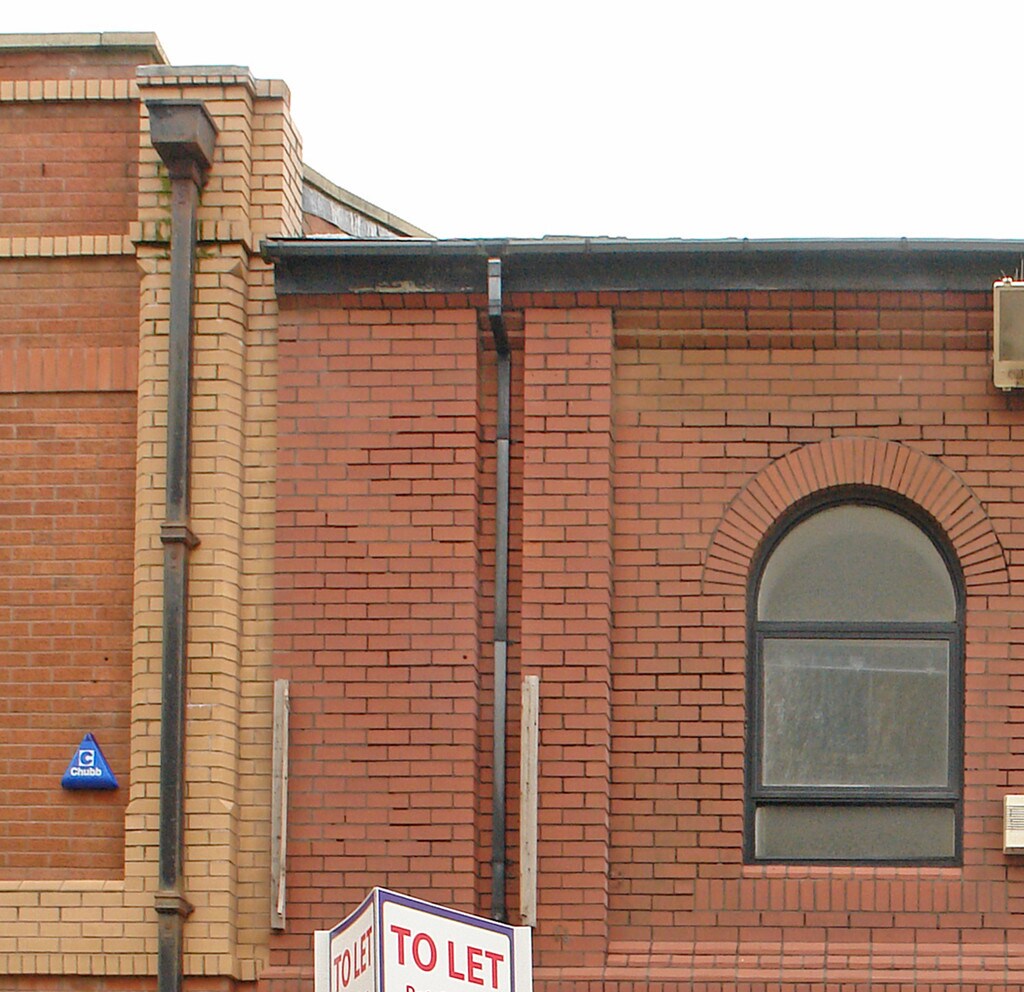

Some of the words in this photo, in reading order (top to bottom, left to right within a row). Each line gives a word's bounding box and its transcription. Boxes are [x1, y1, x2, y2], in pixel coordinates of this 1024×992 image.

[70, 766, 103, 777] Chubb
[333, 949, 350, 992] TO
[354, 926, 373, 980] LET
[390, 924, 437, 972] TO
[448, 940, 504, 989] LET
